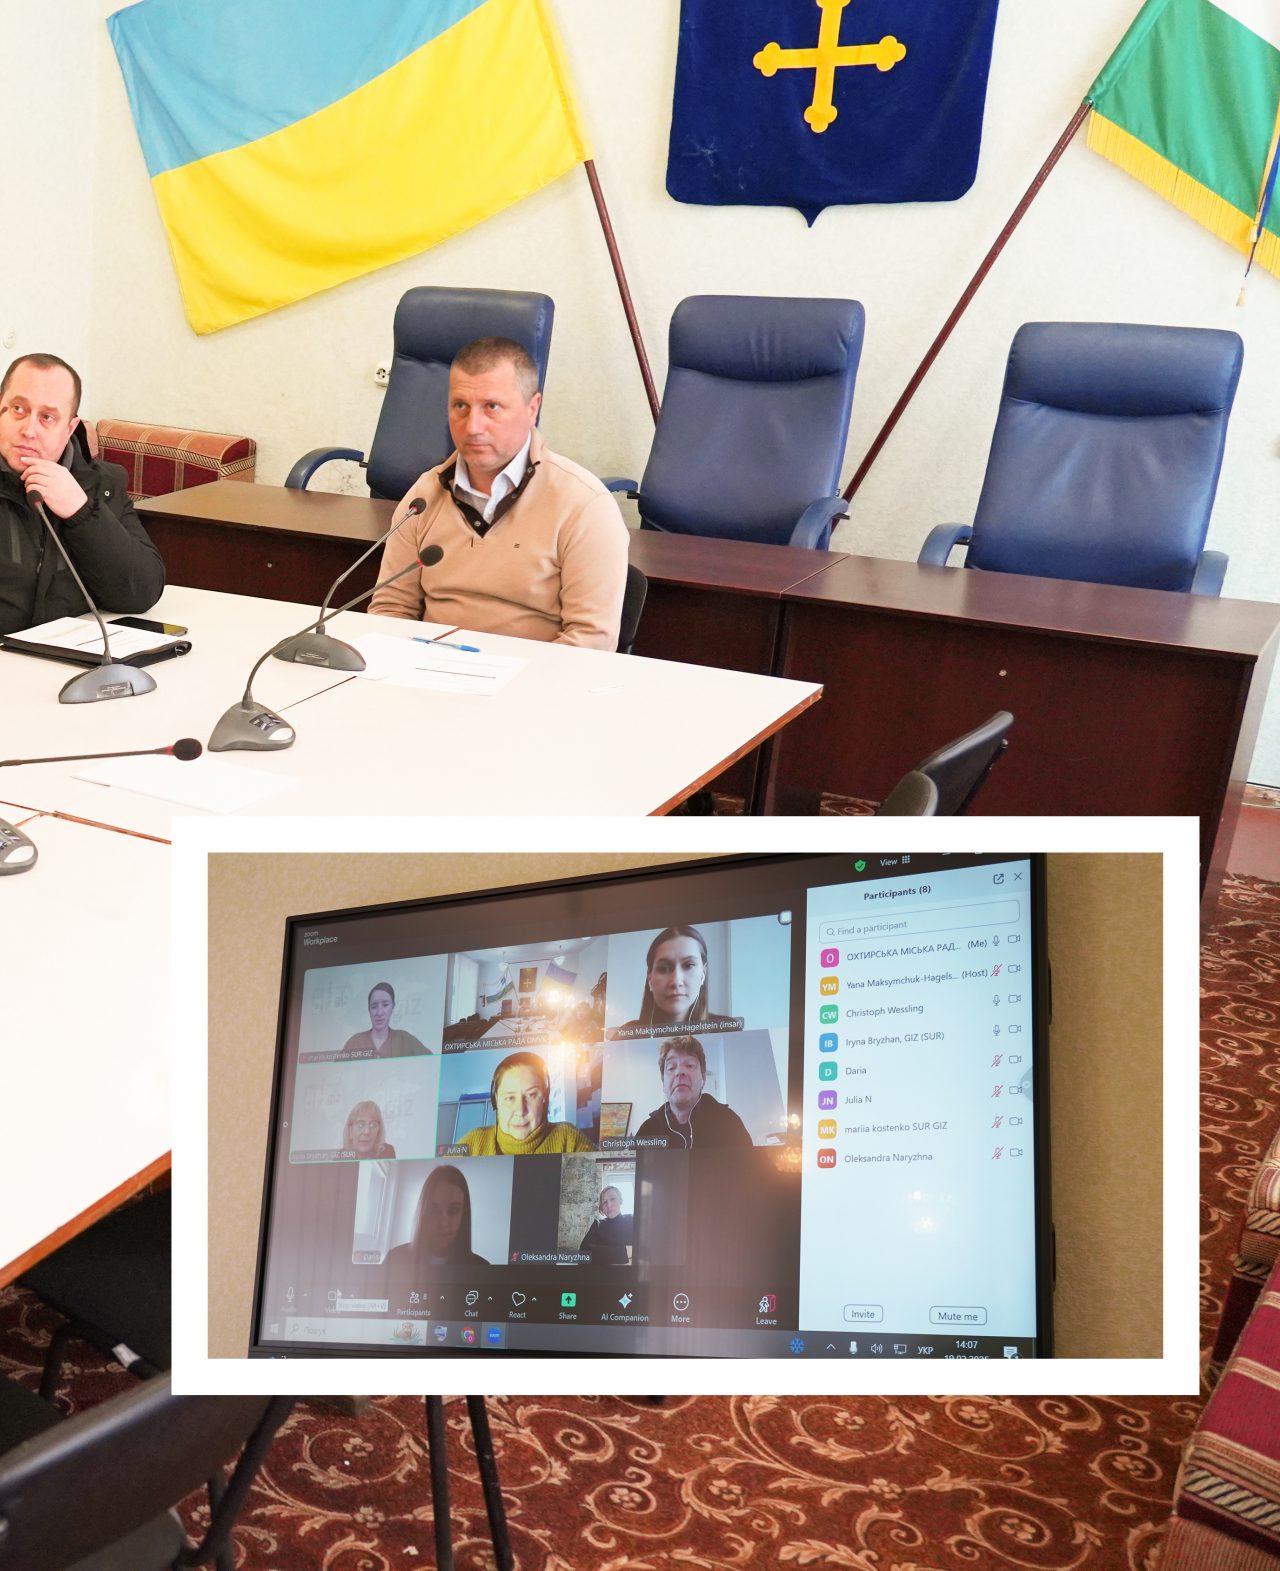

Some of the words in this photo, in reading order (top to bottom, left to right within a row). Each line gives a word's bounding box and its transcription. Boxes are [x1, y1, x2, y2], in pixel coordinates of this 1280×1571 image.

[880, 858, 898, 867] View
[864, 886, 916, 900] Participants
[919, 885, 931, 895] (8)
[837, 925, 855, 936] Find
[863, 920, 907, 933] participant
[303, 935, 338, 946] Workplace
[846, 948, 898, 961] ОХТИРСЬКА
[900, 945, 935, 956] МІСЬКА
[967, 939, 988, 949] (Me)
[846, 980, 865, 990] Yana
[961, 968, 988, 980] (Host)
[822, 982, 837, 992] YM
[822, 1010, 837, 1020] CW
[846, 1006, 886, 1018] Christoph
[887, 1005, 924, 1015] Wessling
[618, 1028, 634, 1037] Yana
[635, 1022, 718, 1036] Maksymchuk-Hagelstein
[824, 1039, 833, 1048] IB
[845, 1037, 866, 1048] Iryna
[867, 1034, 902, 1046] Bryzhan,
[904, 1033, 919, 1042] GIZ
[920, 1032, 945, 1042] (SUR)
[444, 1041, 482, 1051] ОХТИРСЬКА
[482, 1039, 507, 1048] МІСЬКА
[825, 1068, 832, 1077] D
[845, 1067, 867, 1075] Daria
[822, 1097, 834, 1106] JN
[844, 1095, 863, 1104] Julia
[865, 1095, 872, 1103] N
[820, 1126, 835, 1135] MK
[845, 1125, 870, 1134] mariia
[872, 1123, 910, 1133] kostenko
[912, 1122, 930, 1131] SUR
[932, 1121, 948, 1130] GIZ
[602, 1139, 635, 1150] Christoph
[636, 1137, 667, 1148] Wessling
[447, 1145, 461, 1154] Julia
[462, 1145, 467, 1153] N
[819, 1155, 834, 1164] ON
[844, 1153, 891, 1163] Oleksandra
[892, 1152, 933, 1164] Naryzhna
[521, 1252, 557, 1261] Oleksandra
[558, 1252, 590, 1263] Naryzhna
[396, 1308, 431, 1317] Participants
[464, 1310, 479, 1318] Chat
[509, 1311, 526, 1319] React
[558, 1312, 577, 1320] Share
[851, 1310, 875, 1319] Invite
[938, 1312, 962, 1321] Mute
[964, 1313, 978, 1321] me
[601, 1314, 608, 1322] AI
[610, 1313, 649, 1323] Companion
[671, 1314, 690, 1323] More
[755, 1317, 777, 1325] Leave
[955, 1340, 978, 1349] 14:07
[917, 1346, 934, 1355] УКР
